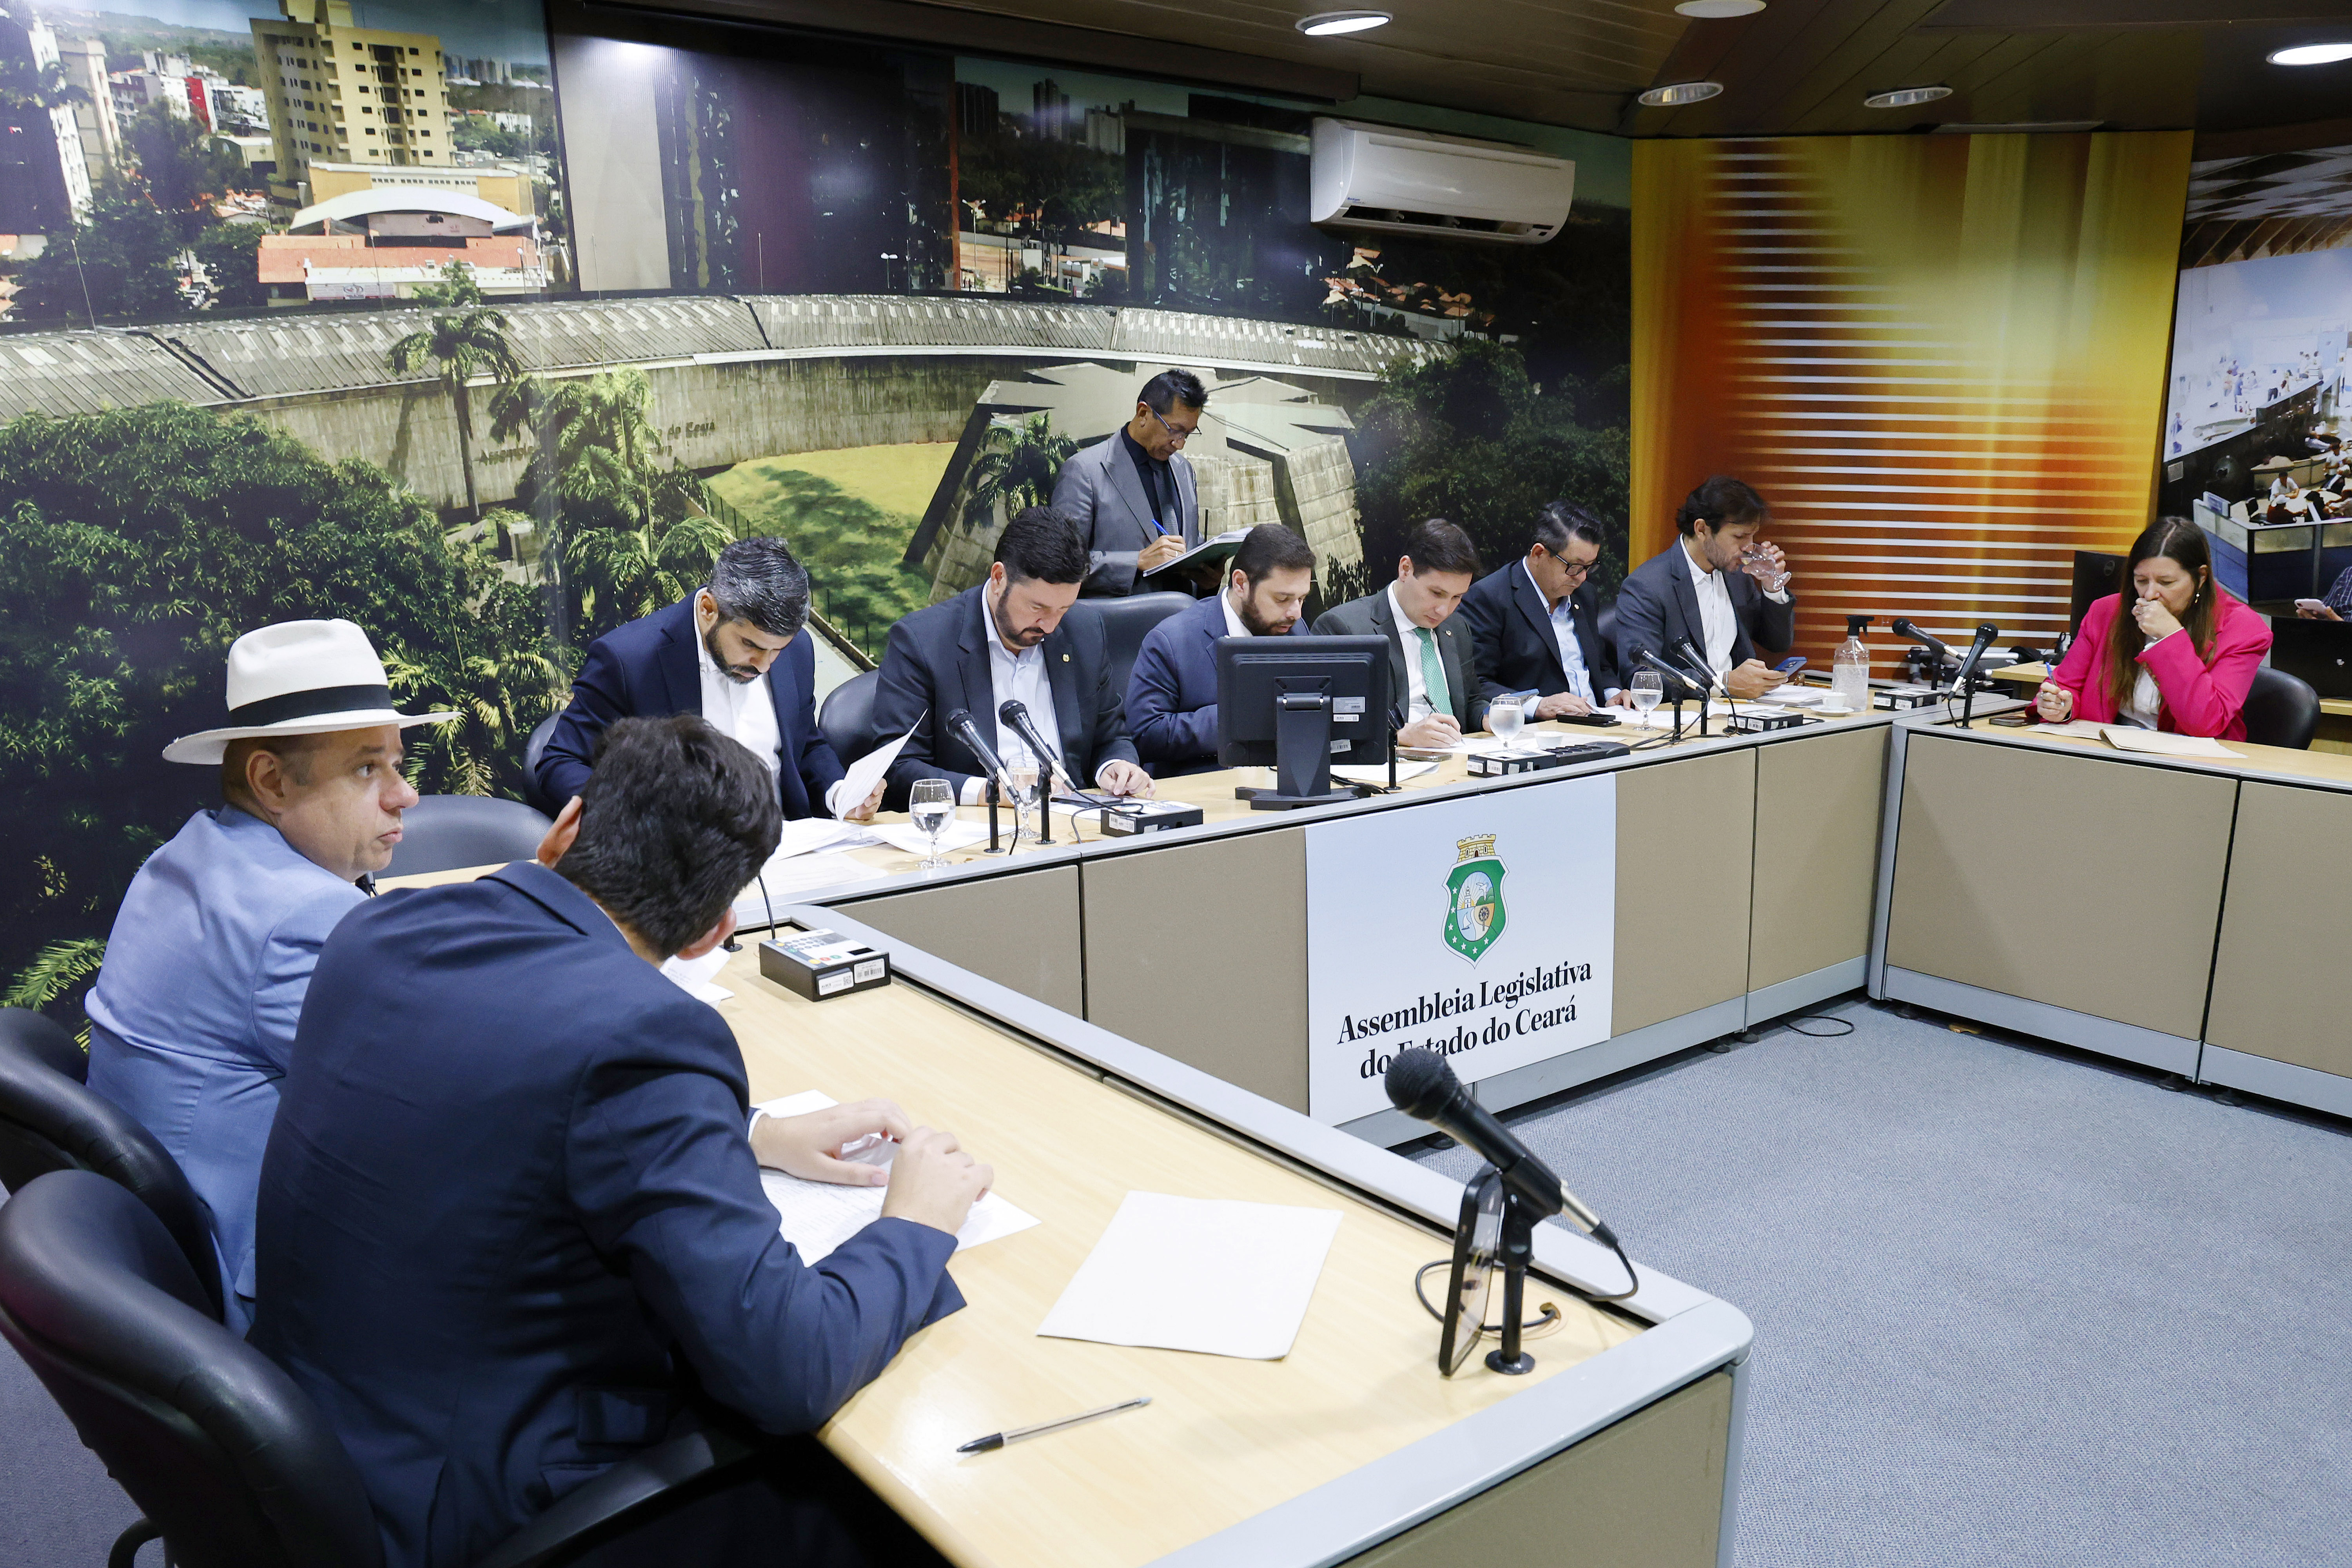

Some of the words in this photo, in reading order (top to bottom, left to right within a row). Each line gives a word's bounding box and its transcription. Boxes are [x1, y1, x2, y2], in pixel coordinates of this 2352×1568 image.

[1337, 988, 1475, 1045] Assembleia
[1479, 961, 1592, 1009] Legislativa
[1360, 1048, 1392, 1079] do
[1482, 1017, 1510, 1045] do
[1515, 994, 1577, 1036] Ceará
